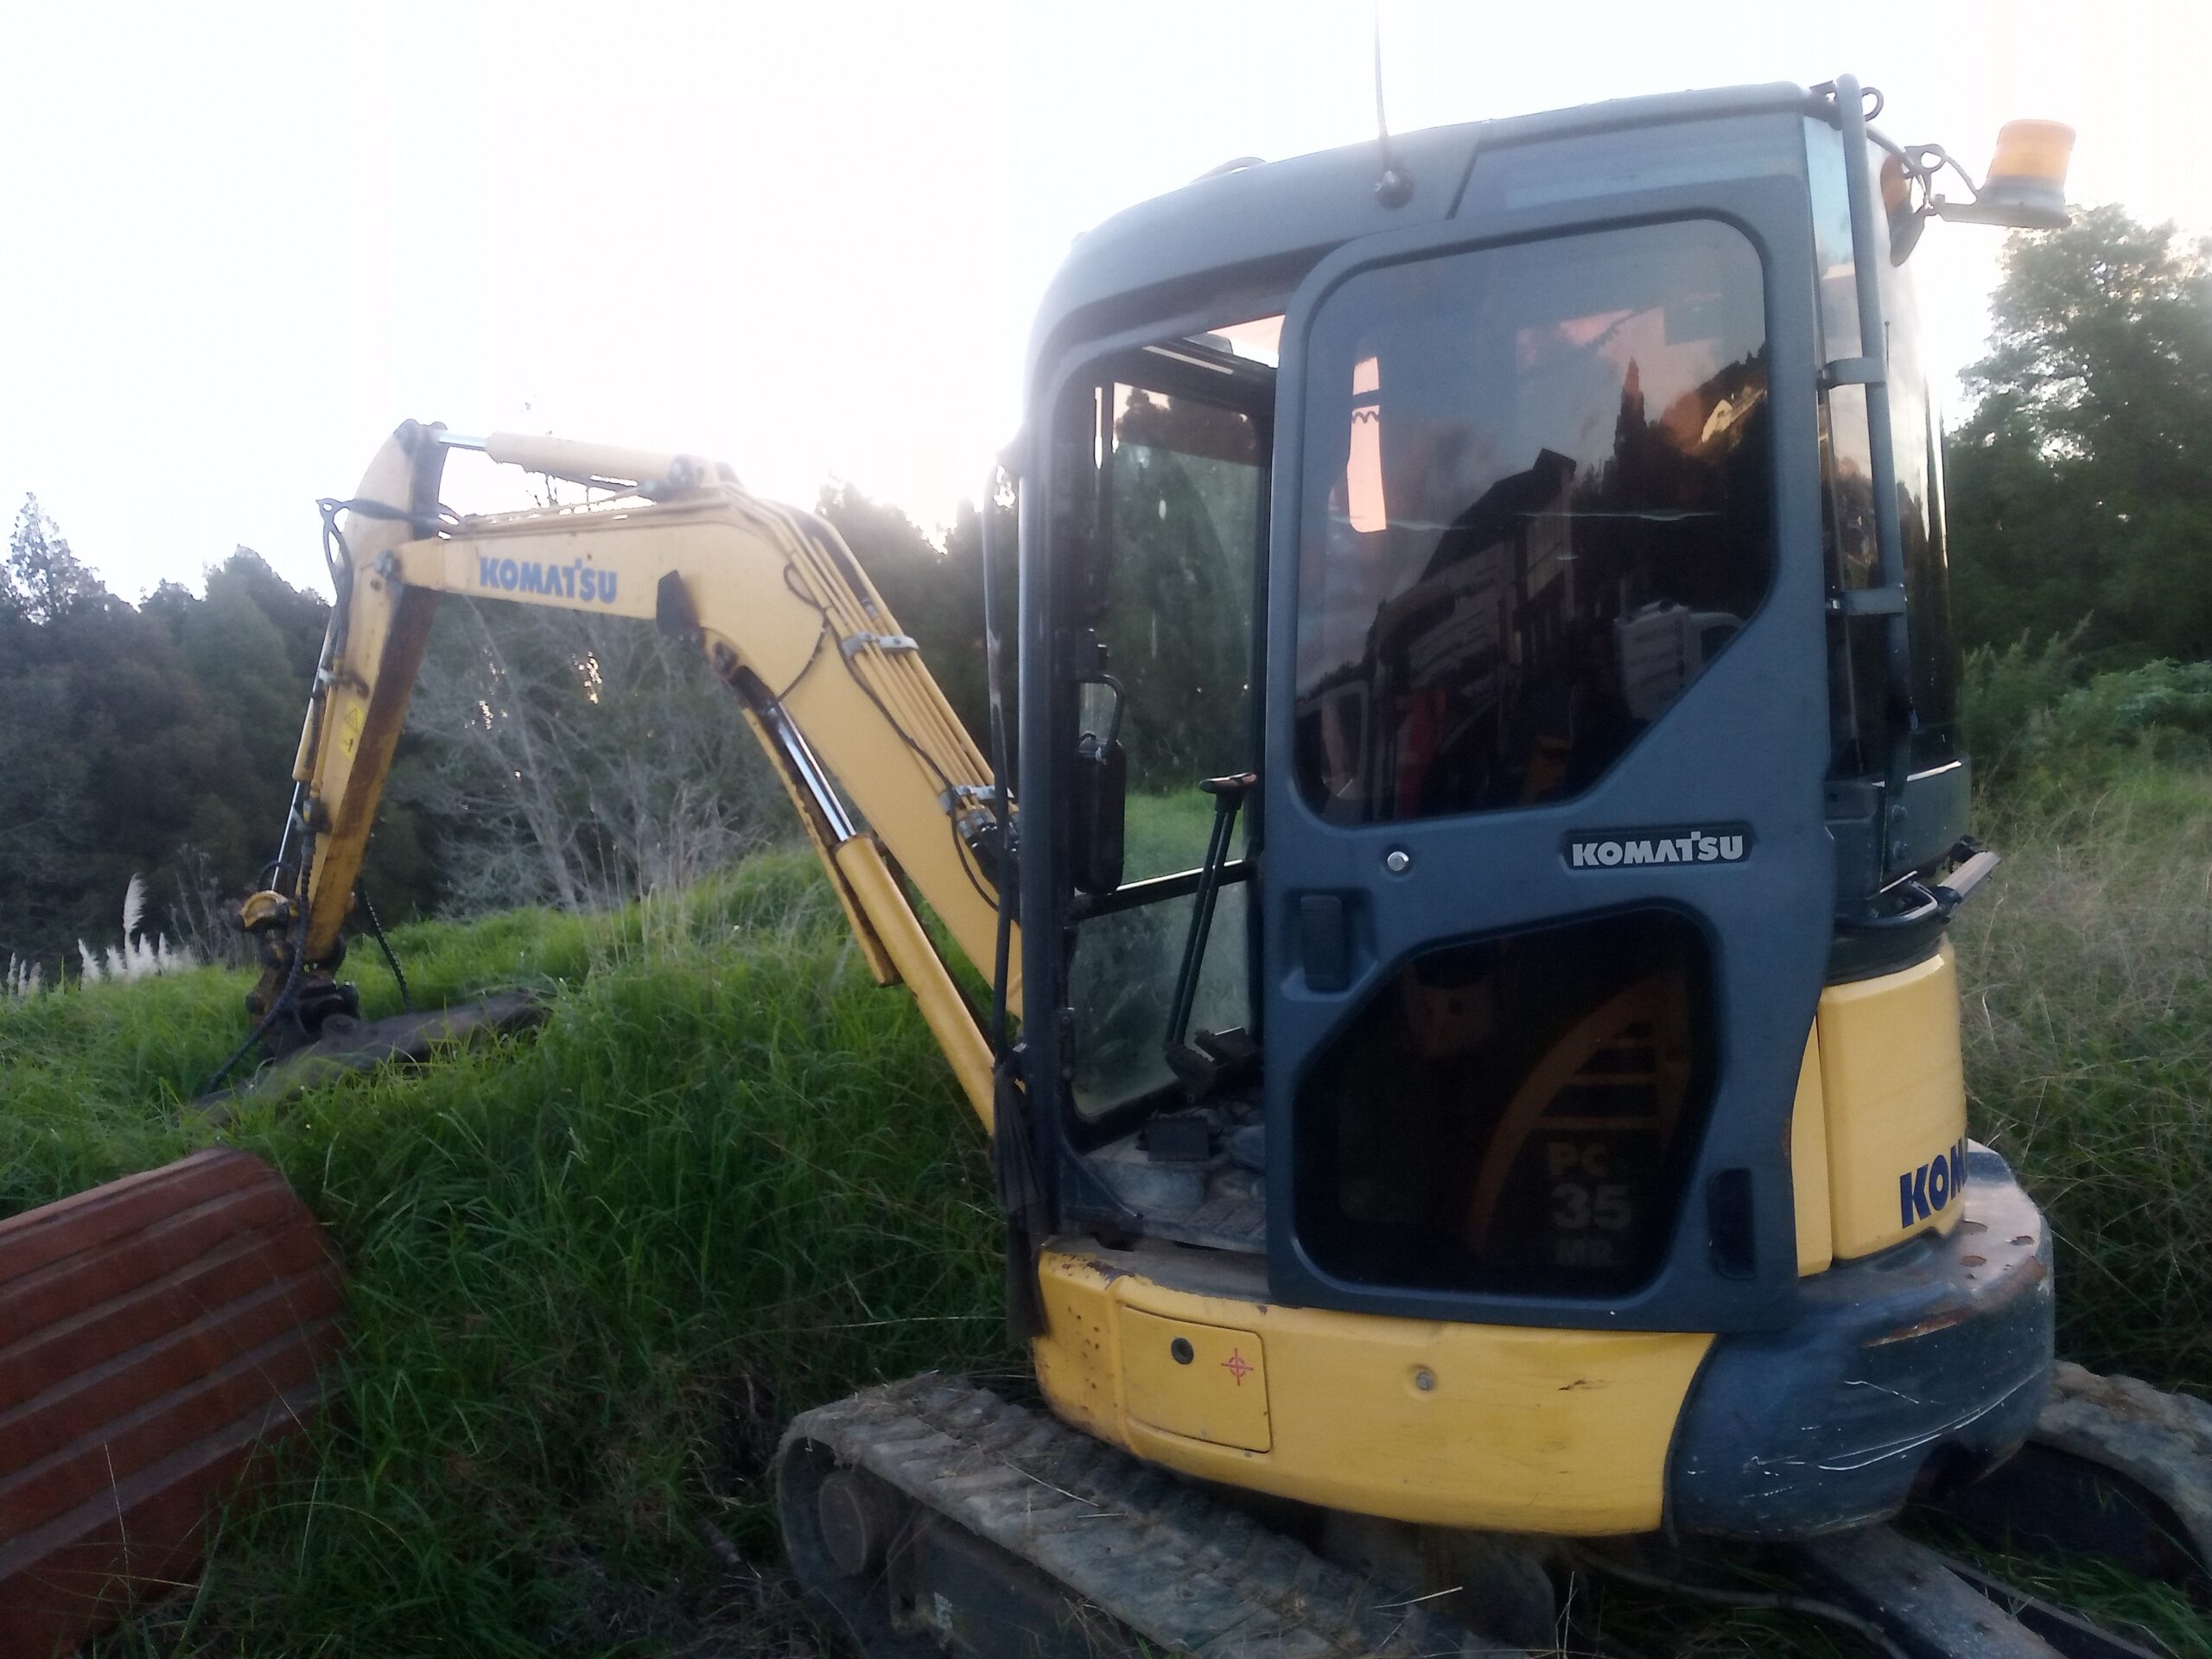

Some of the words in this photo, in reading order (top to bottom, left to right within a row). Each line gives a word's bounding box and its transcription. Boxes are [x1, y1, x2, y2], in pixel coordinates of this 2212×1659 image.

[480, 557, 617, 603] KOMATSU
[1573, 831, 1743, 866] KOMATSU
[1551, 1183, 1632, 1230] 35
